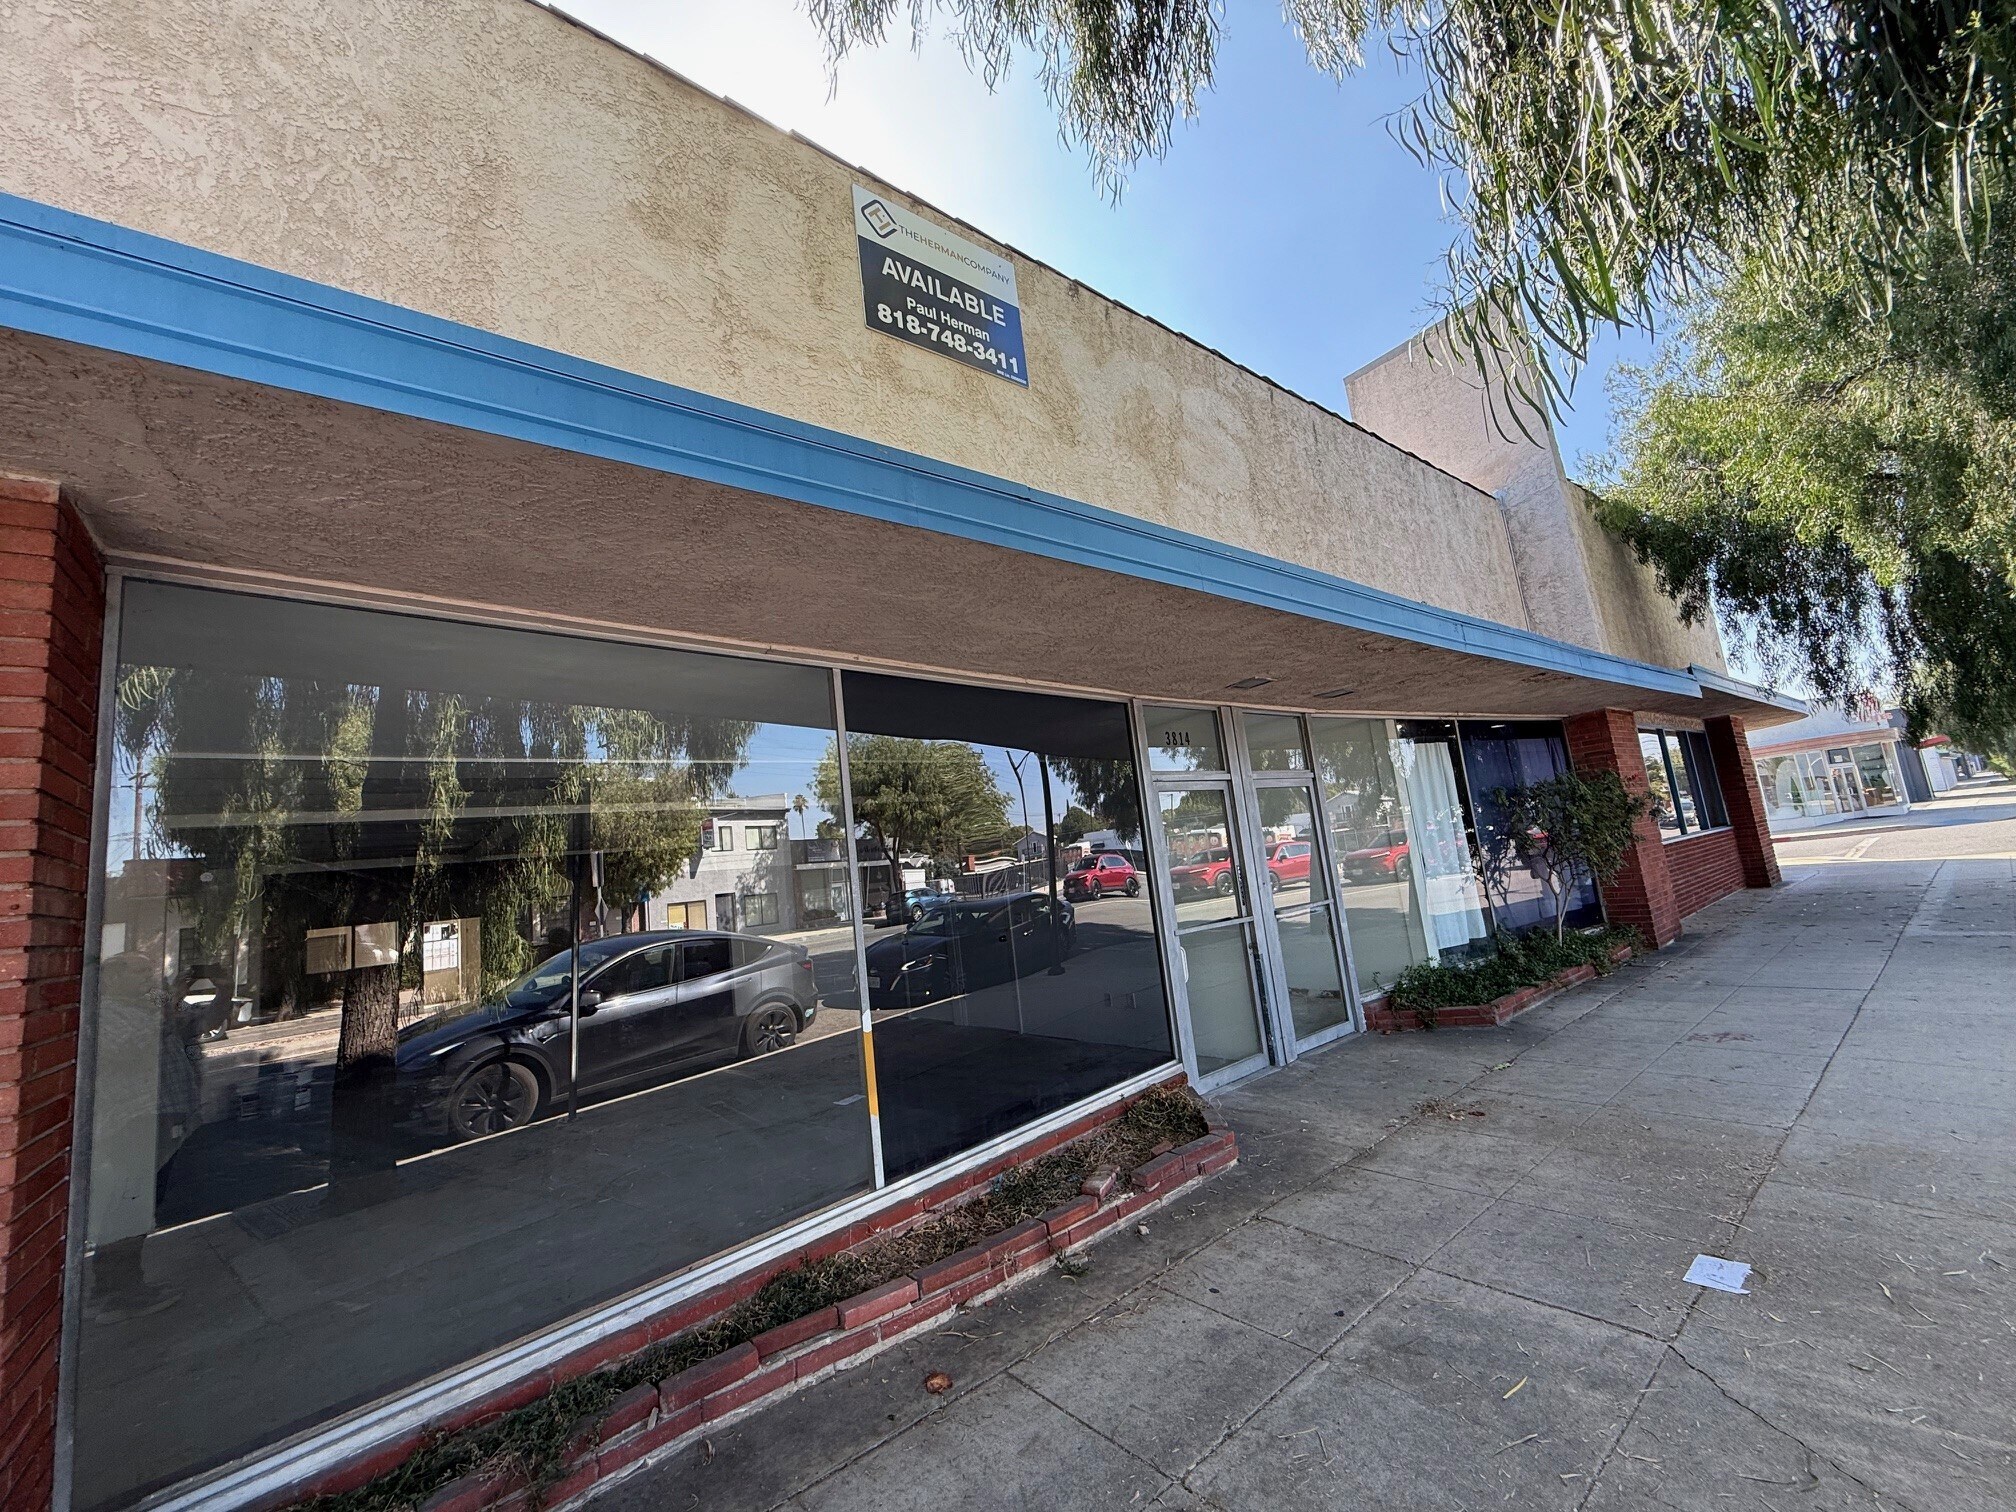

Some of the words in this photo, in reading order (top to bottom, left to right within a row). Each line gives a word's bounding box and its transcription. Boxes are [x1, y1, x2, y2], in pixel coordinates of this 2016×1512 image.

[882, 257, 1006, 327] AVAILABLE
[906, 296, 937, 321] Paul
[940, 310, 990, 342] Herman
[877, 303, 1019, 374] 818-748-3411
[1165, 731, 1190, 746] 3814
